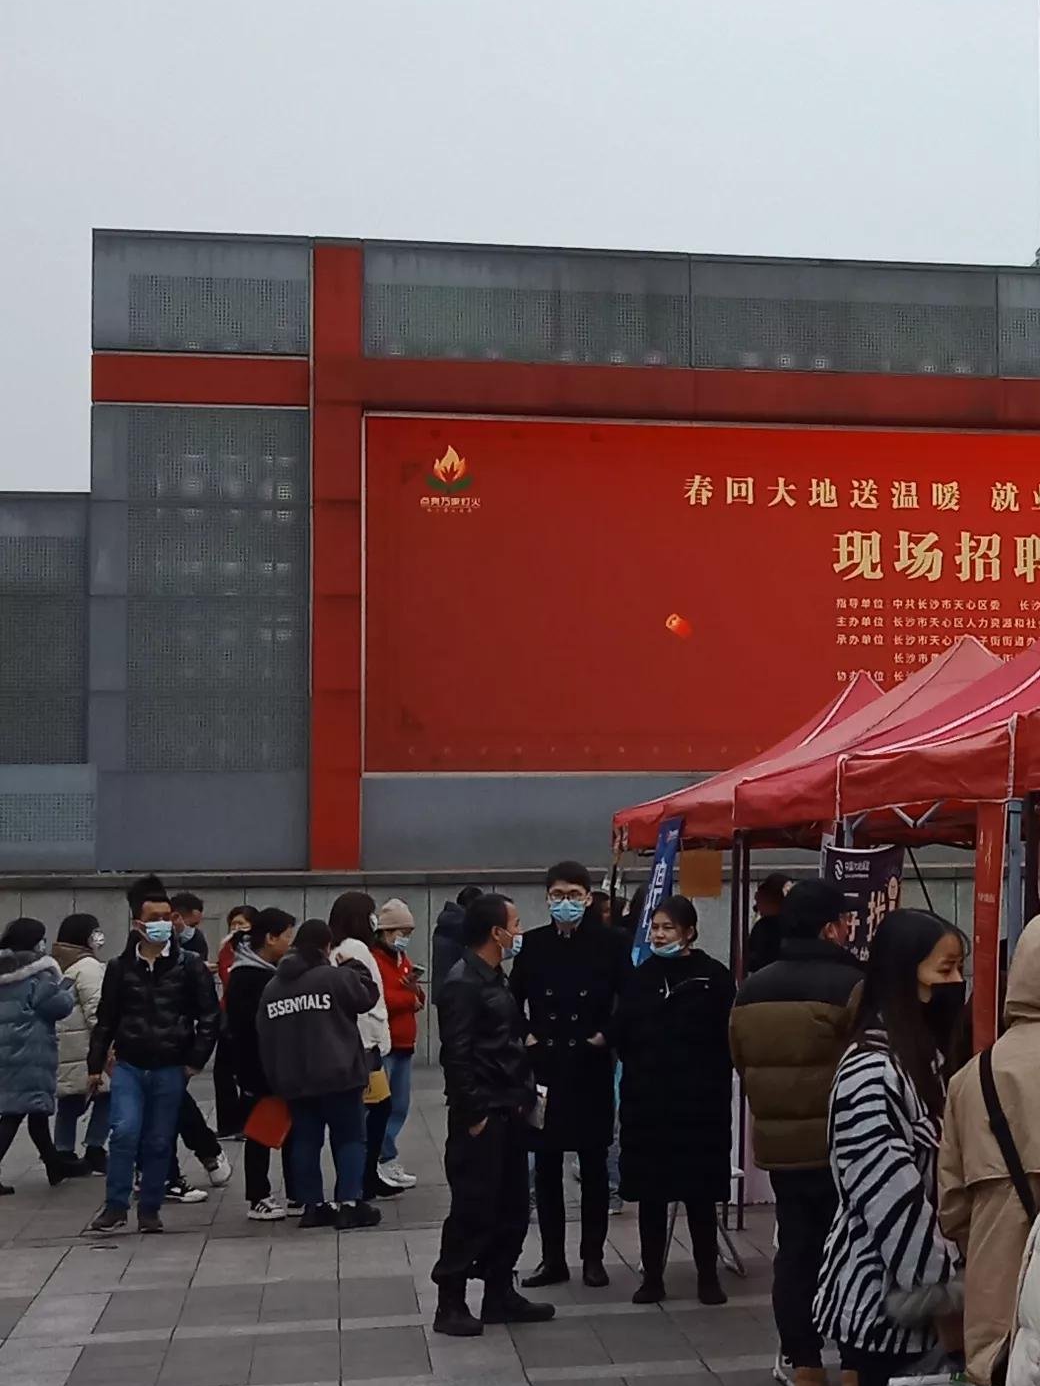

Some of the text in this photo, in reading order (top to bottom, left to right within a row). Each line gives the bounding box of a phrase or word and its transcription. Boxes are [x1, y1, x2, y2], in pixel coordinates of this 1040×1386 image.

[684, 475, 960, 512] 春回大地送温暖
[836, 671, 885, 682] 协办位
[267, 993, 331, 1019] ESSENTIALS
